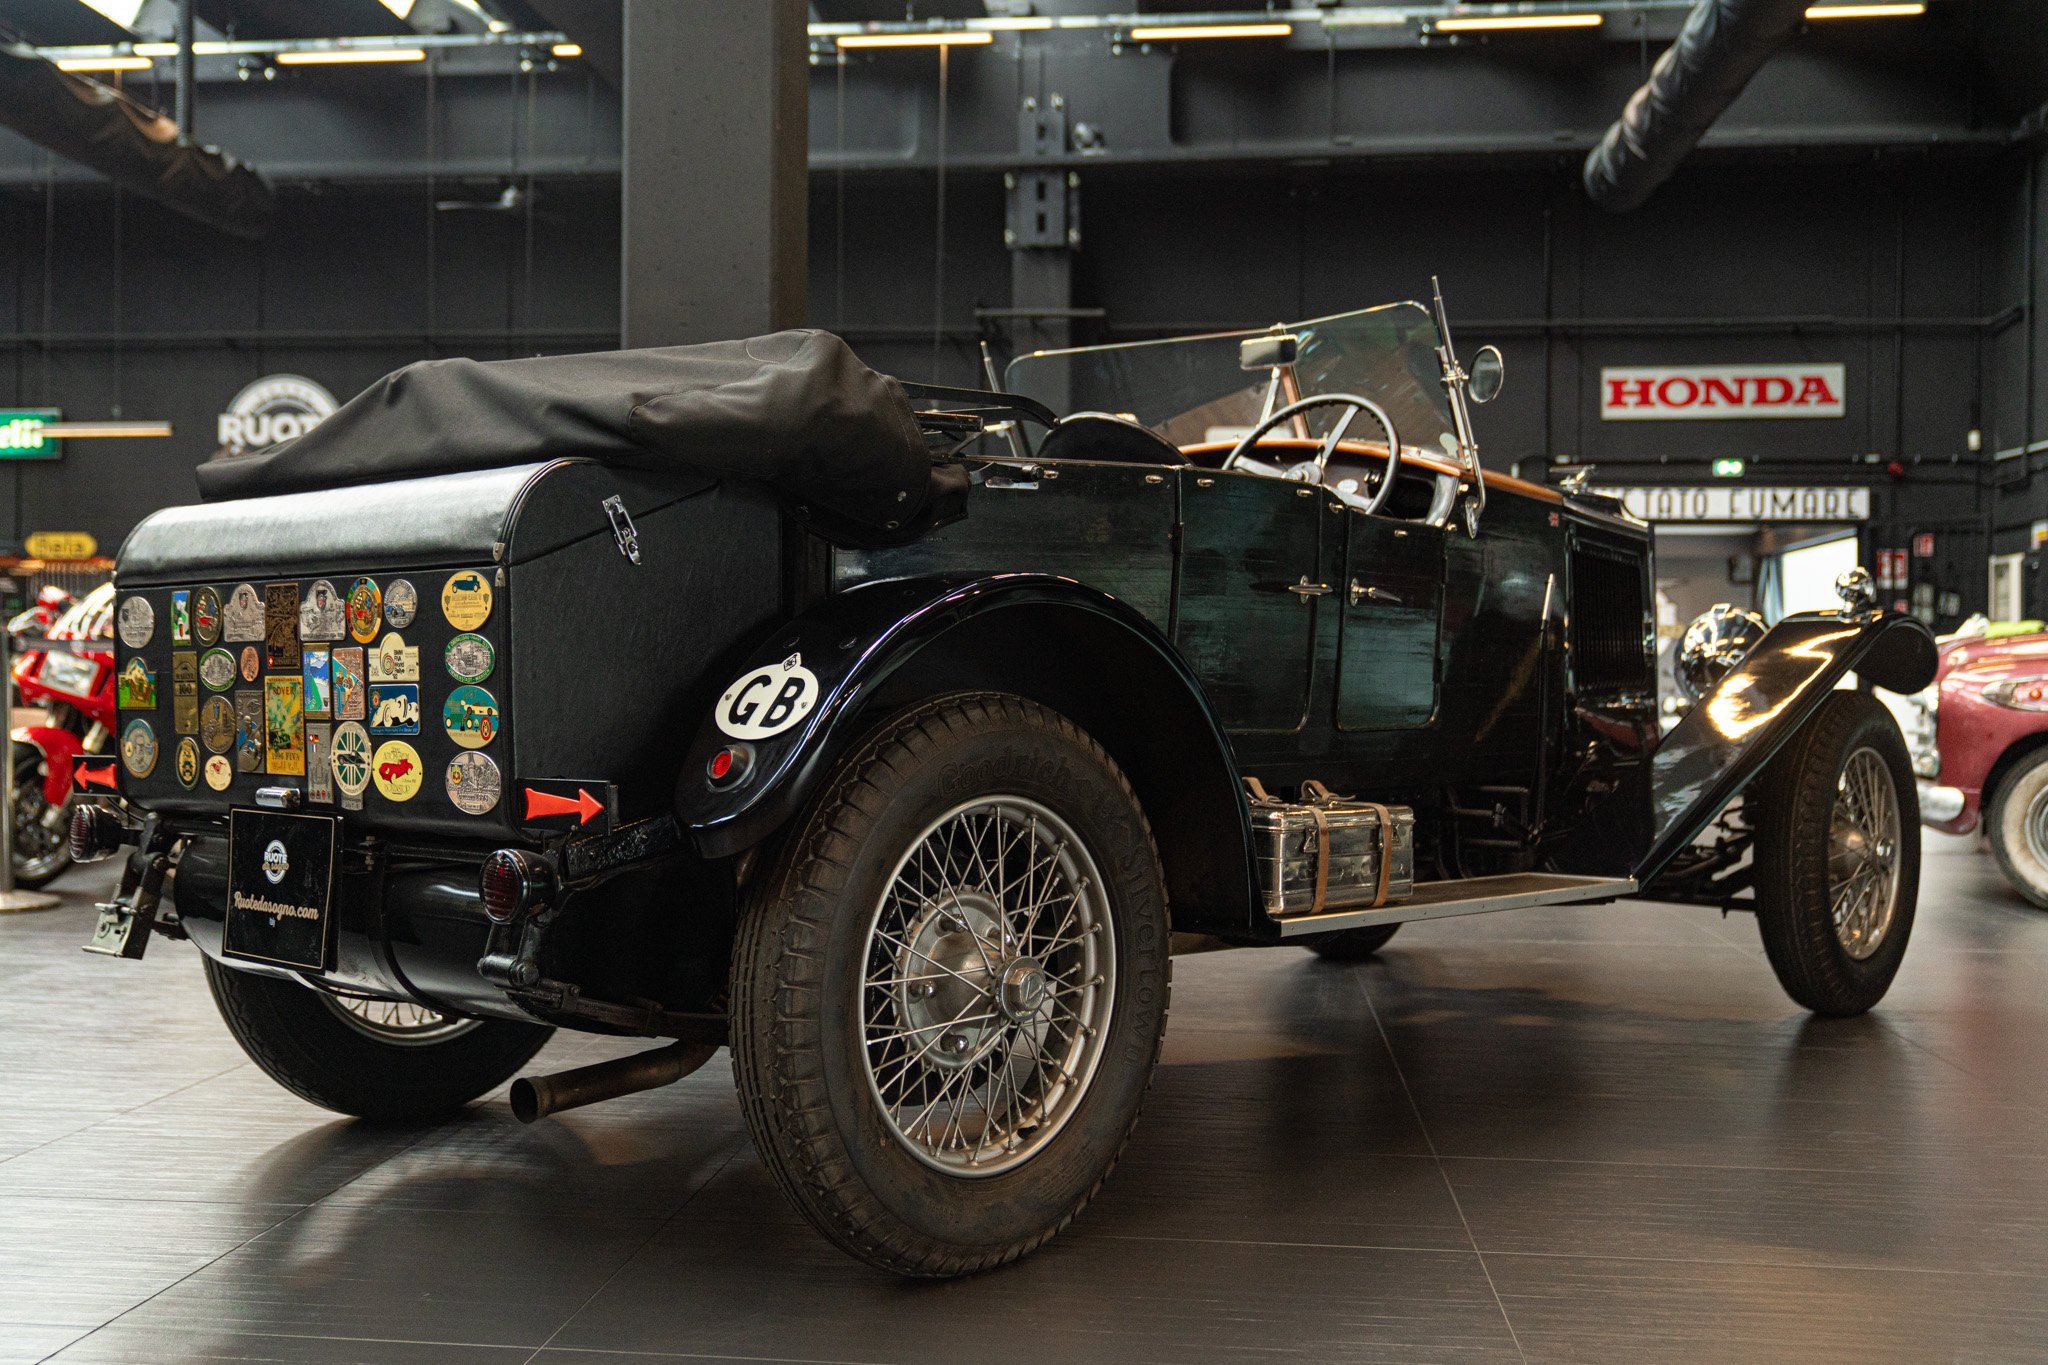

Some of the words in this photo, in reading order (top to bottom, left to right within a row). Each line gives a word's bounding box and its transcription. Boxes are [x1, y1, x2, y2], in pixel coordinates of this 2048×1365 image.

[1607, 376, 1839, 408] HONDA
[218, 413, 324, 447] RUOT
[1729, 487, 1860, 519] FUMARE
[728, 674, 806, 728] GB
[264, 851, 288, 863] RUOTE
[234, 891, 319, 920] Ruotedasogno.com
